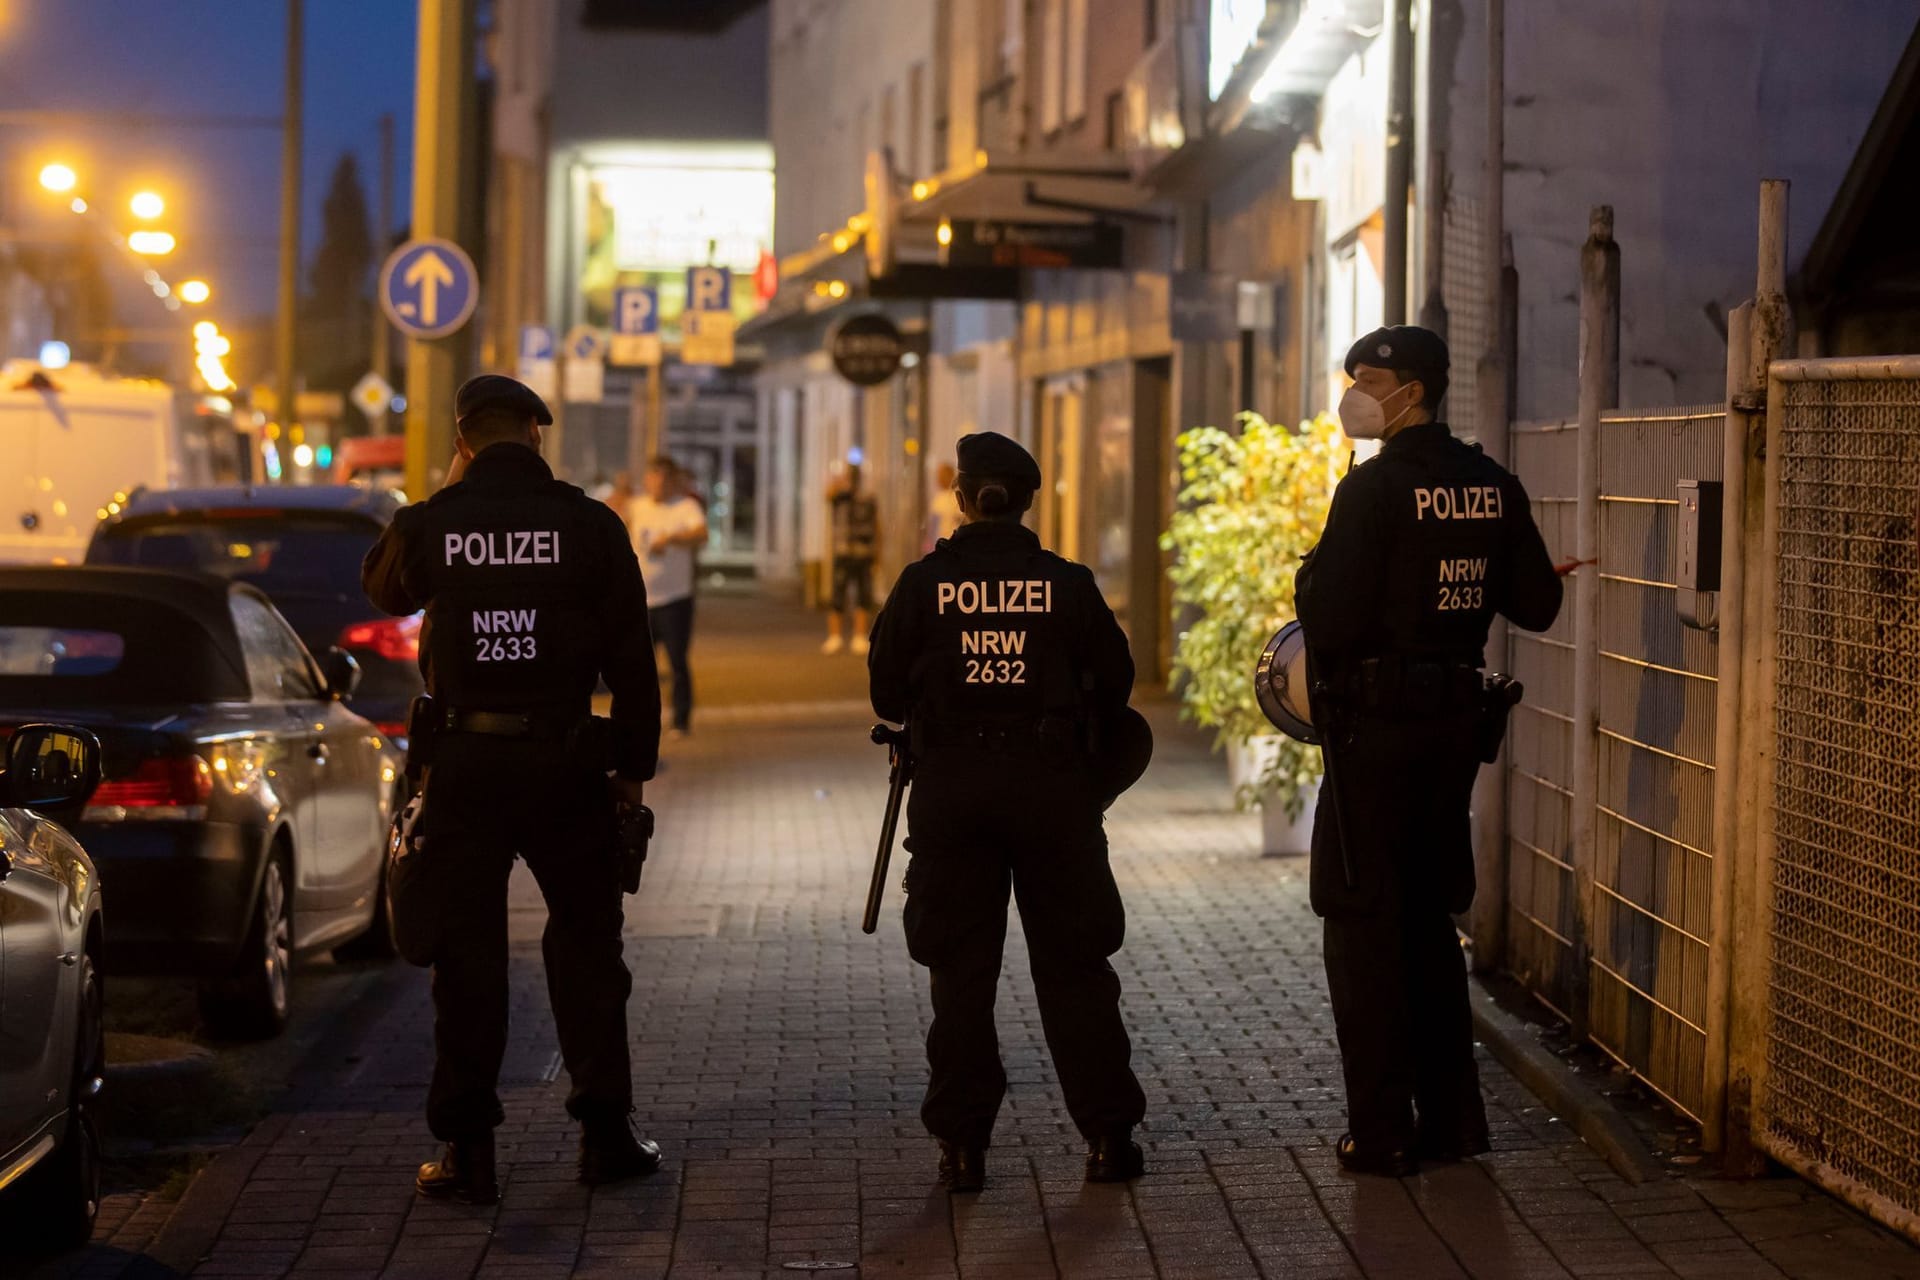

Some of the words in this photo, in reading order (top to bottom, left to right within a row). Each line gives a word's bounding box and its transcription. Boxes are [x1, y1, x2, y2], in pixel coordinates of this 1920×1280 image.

[620, 292, 651, 333] P
[1414, 487, 1502, 520] POLIZEI
[445, 531, 560, 566] POLIZEI
[1439, 558, 1488, 582] NRW
[937, 580, 1052, 615] POLIZEI
[1438, 587, 1483, 610] 2633
[472, 609, 537, 633] NRW
[475, 636, 537, 661] 2633
[961, 631, 1026, 655] NRW
[965, 660, 1026, 684] 2632
